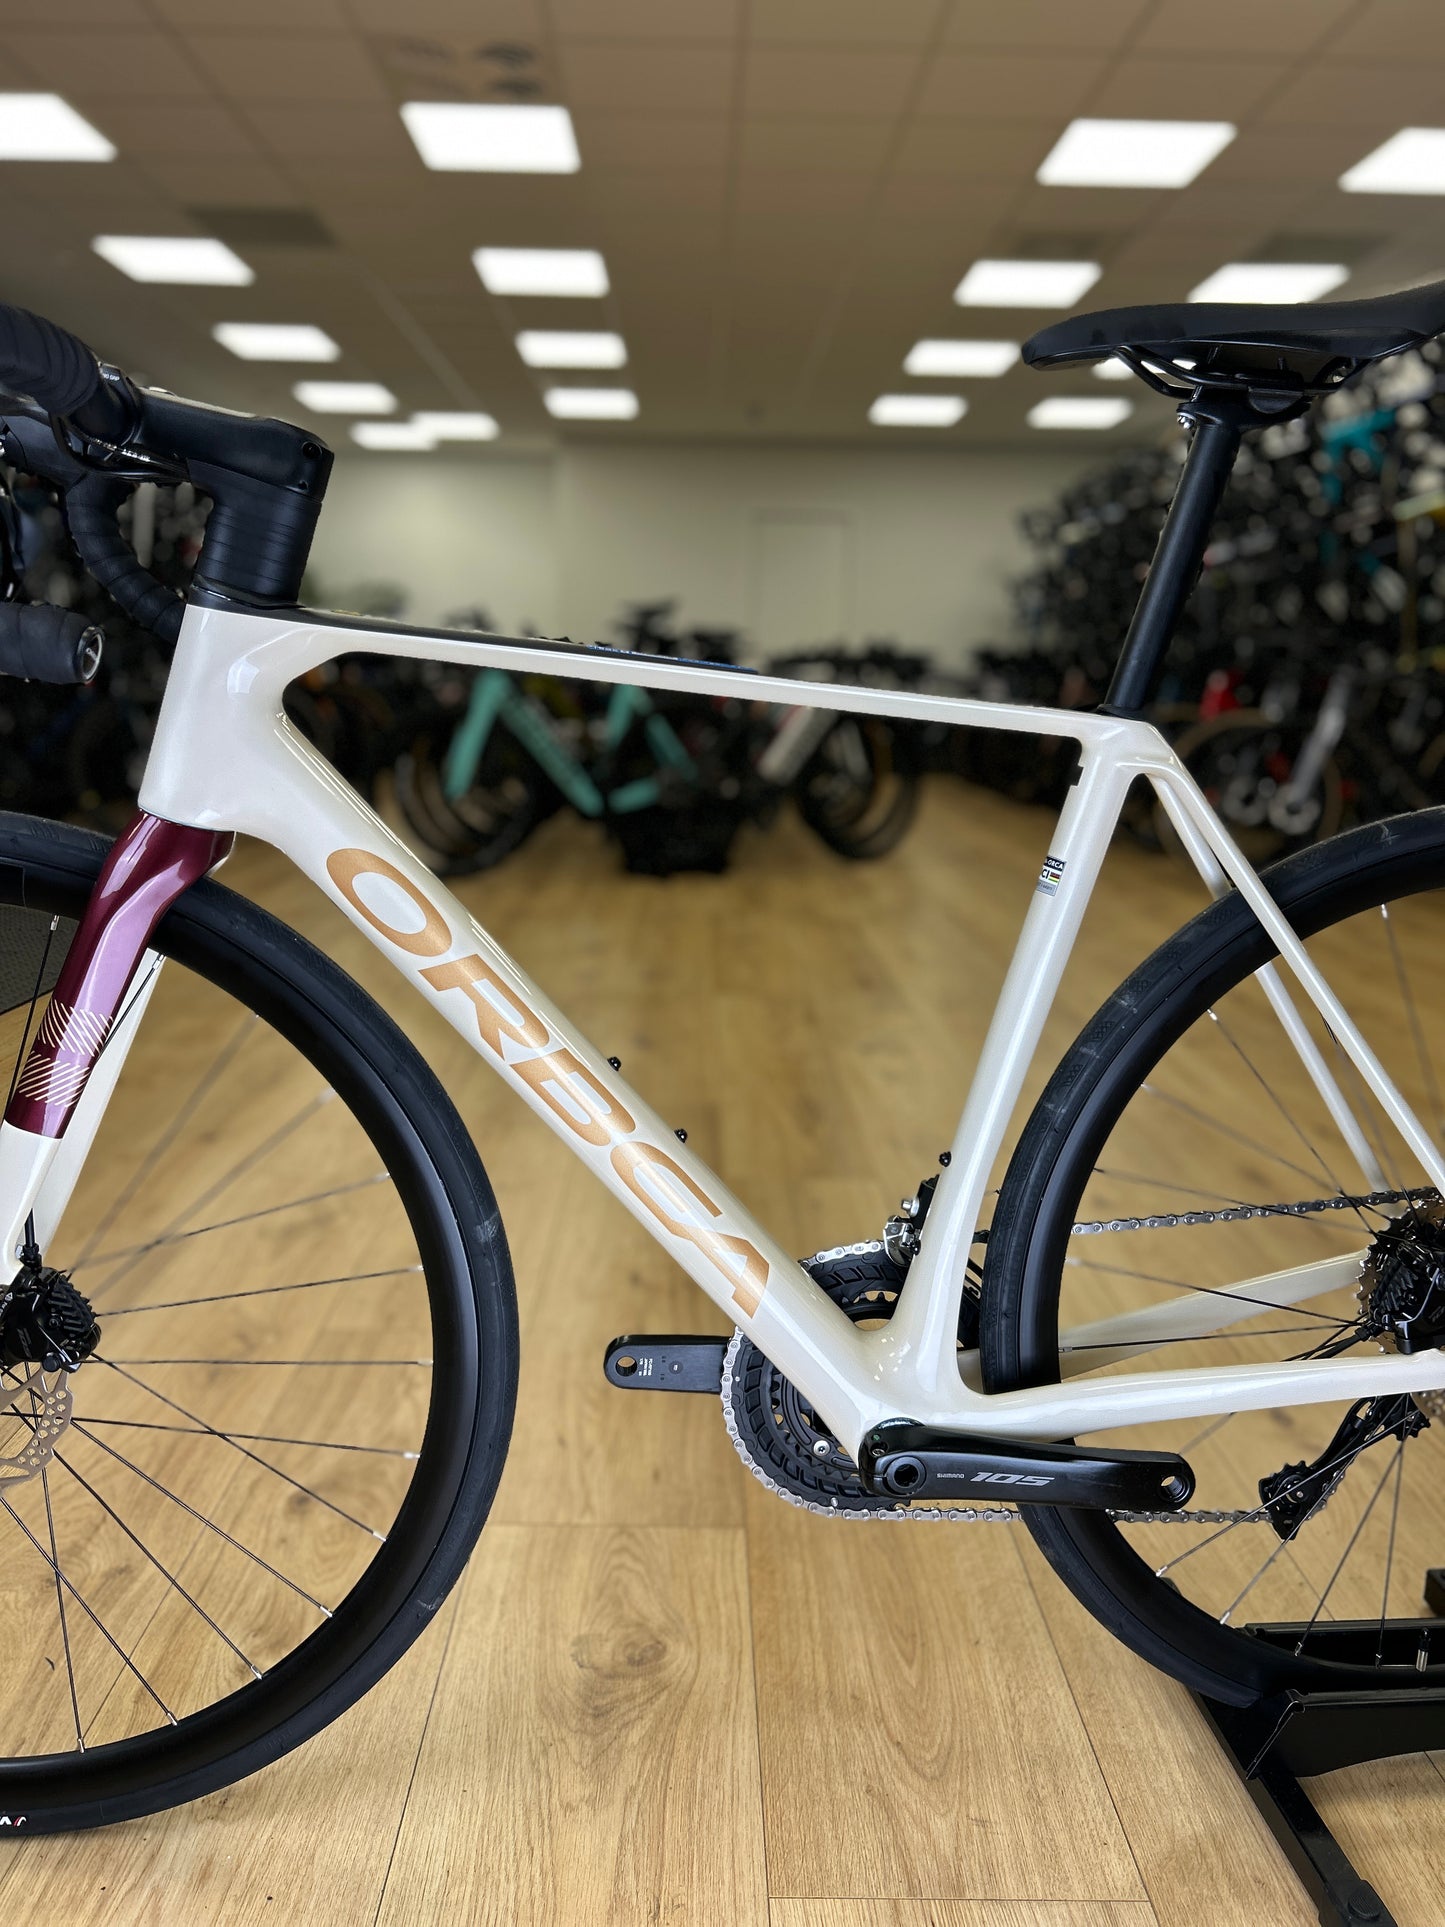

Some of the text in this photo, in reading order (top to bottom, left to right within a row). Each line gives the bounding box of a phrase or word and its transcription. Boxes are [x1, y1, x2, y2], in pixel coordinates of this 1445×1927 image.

[1047, 859, 1063, 868] ORCA
[1041, 868, 1050, 879] CI
[326, 848, 770, 1319] ORBEA
[970, 1471, 1055, 1486] 105
